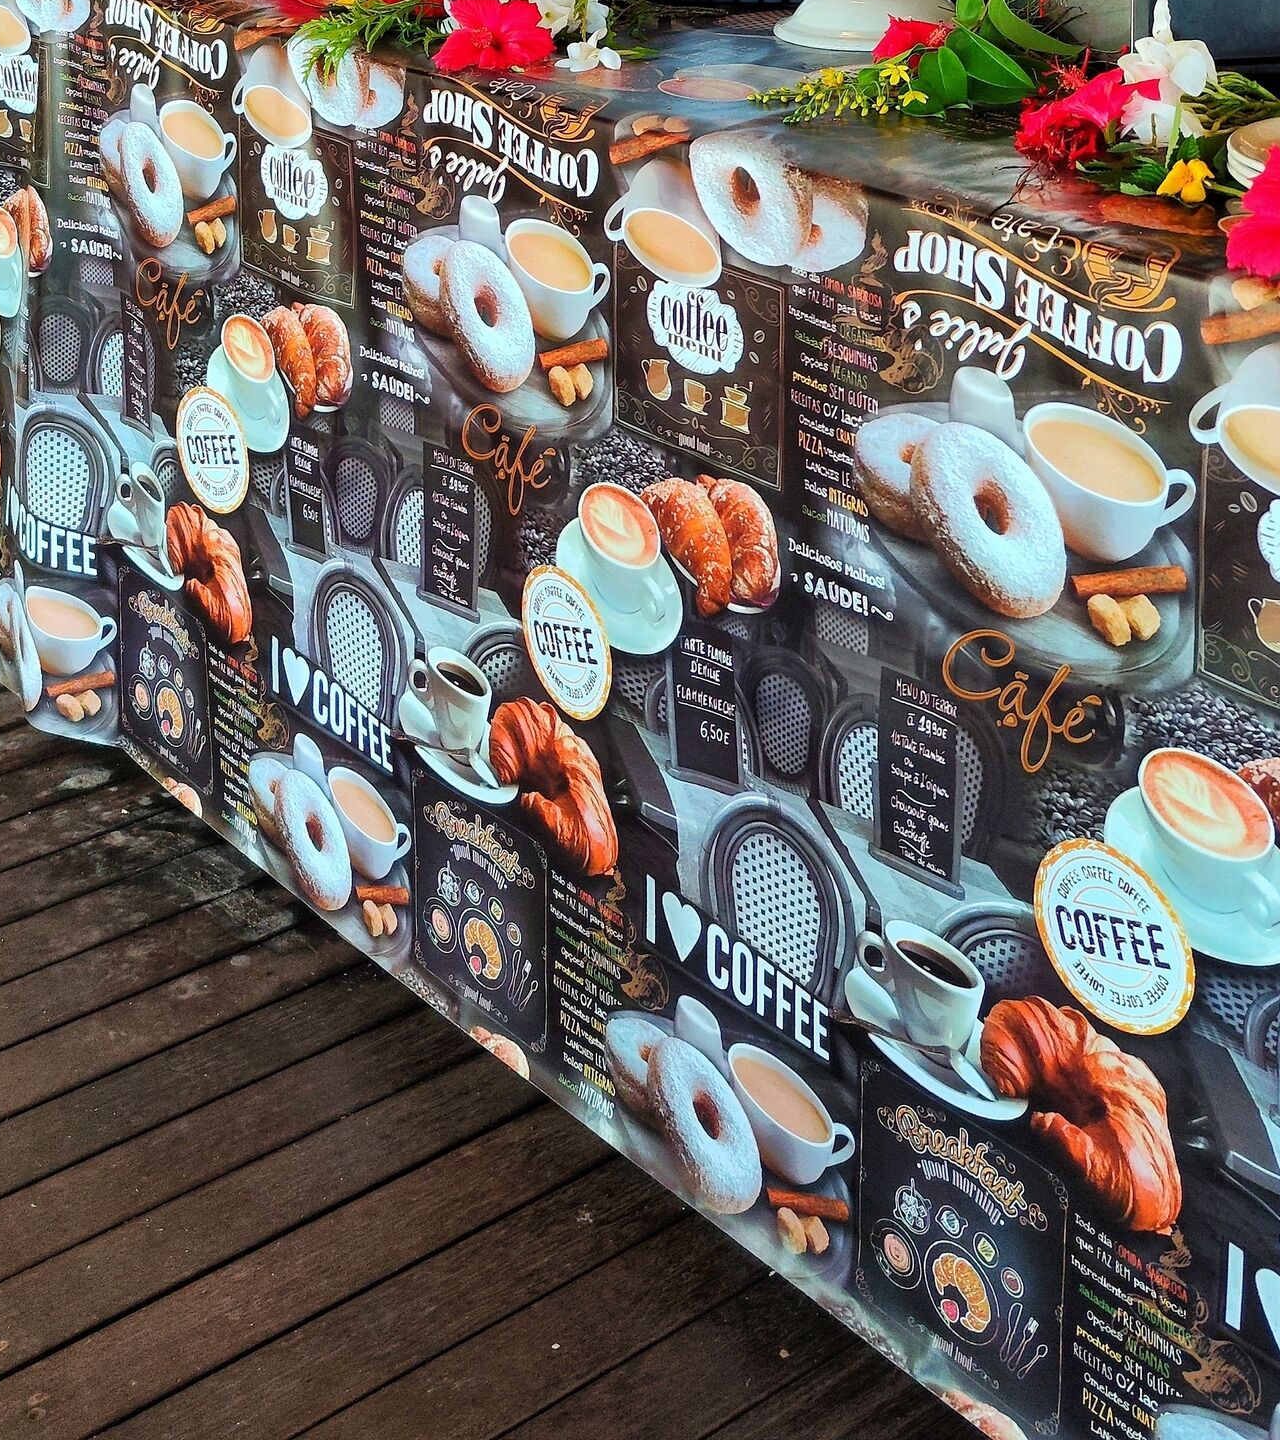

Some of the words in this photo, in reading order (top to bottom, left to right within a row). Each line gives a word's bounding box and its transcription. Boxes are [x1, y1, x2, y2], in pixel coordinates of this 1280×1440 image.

[156, 19, 228, 80] COFFEE
[423, 90, 493, 149] SHOP
[270, 153, 315, 198] coffee
[498, 118, 599, 197] COFFEE
[366, 258, 382, 277] PIZZA
[894, 230, 1008, 310] SHOP
[660, 291, 728, 351] coffee
[792, 285, 806, 296] que
[808, 288, 819, 303] FAZ
[837, 303, 857, 316] para
[668, 333, 722, 362] menu
[1015, 268, 1182, 384] COFFEE
[359, 345, 398, 368] Deliciosos
[372, 370, 415, 402] SAÚDE!
[791, 388, 821, 414] RECEITAS
[829, 382, 844, 401] SEM
[187, 435, 239, 465] COFFEE
[798, 429, 823, 458] PIZZA
[804, 478, 827, 498] Bolos
[19, 508, 98, 577] COFFEE
[827, 508, 870, 544] NATURAIS
[788, 537, 842, 572] Deliciosos
[804, 571, 869, 616] SAÚDE!
[534, 620, 598, 665] COFFEE
[272, 635, 279, 694] I
[313, 669, 394, 773] COFFEE
[1117, 877, 1151, 914] COFFEE
[1055, 905, 1171, 970] COFFEE
[646, 873, 656, 944] I
[707, 923, 829, 1061] COFFEE
[896, 1104, 1028, 1218] Breakfast
[920, 1159, 950, 1183] good
[952, 1168, 1002, 1226] morning
[1076, 1235, 1094, 1254] que
[1097, 1247, 1112, 1269] FAZ
[1116, 1262, 1130, 1282] BEM
[1134, 1276, 1157, 1299] para
[1225, 1241, 1244, 1331] I
[1124, 1355, 1143, 1380] SEM
[1082, 1387, 1113, 1426] PIZZA
